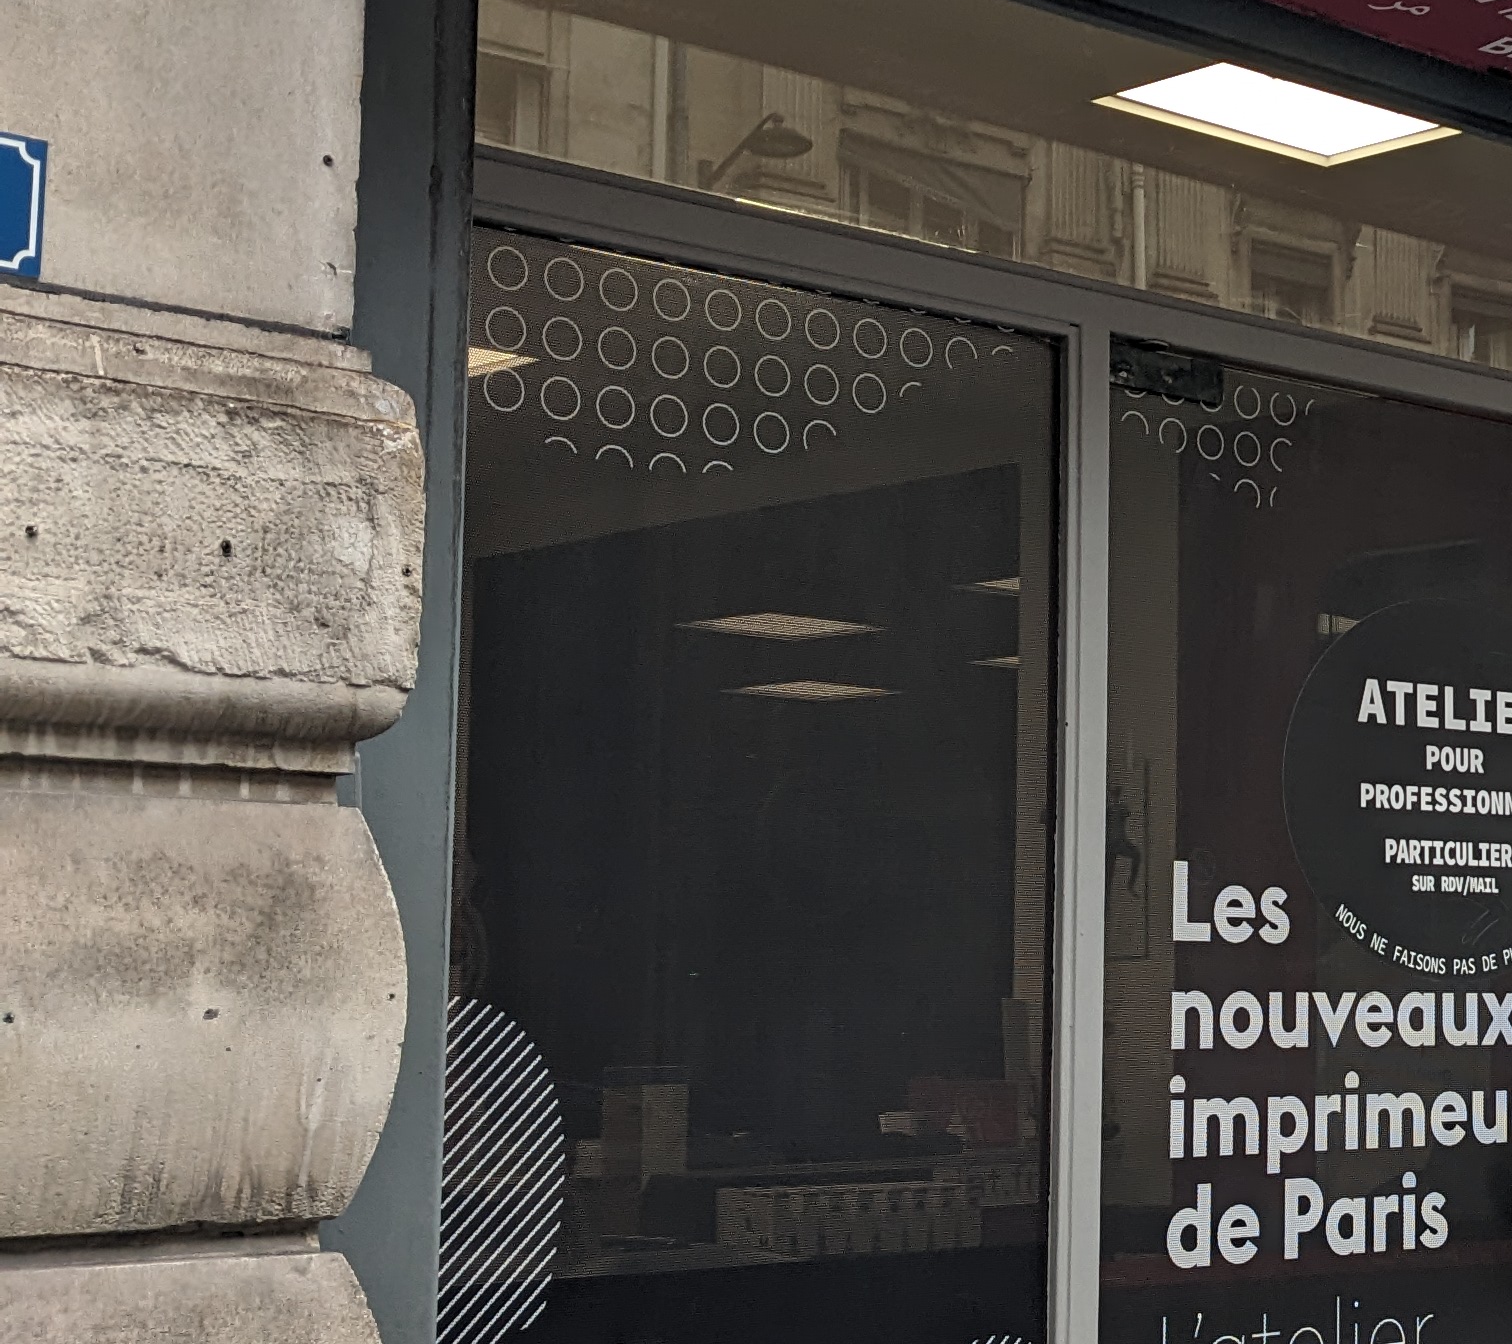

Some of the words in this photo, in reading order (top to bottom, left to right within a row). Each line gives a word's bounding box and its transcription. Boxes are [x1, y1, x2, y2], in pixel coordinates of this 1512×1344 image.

[1425, 744, 1485, 774] POUR
[1172, 860, 1291, 945] Les
[1412, 875, 1434, 892] SUR
[1441, 875, 1499, 895] RDV/MAIL
[1335, 903, 1367, 940] NOUS
[1370, 932, 1389, 955] NE
[1393, 946, 1446, 975] FAISONS
[1453, 958, 1476, 975] PAS
[1482, 954, 1498, 972] DE
[1166, 1182, 1261, 1269] de
[1284, 1171, 1449, 1260] Paris
